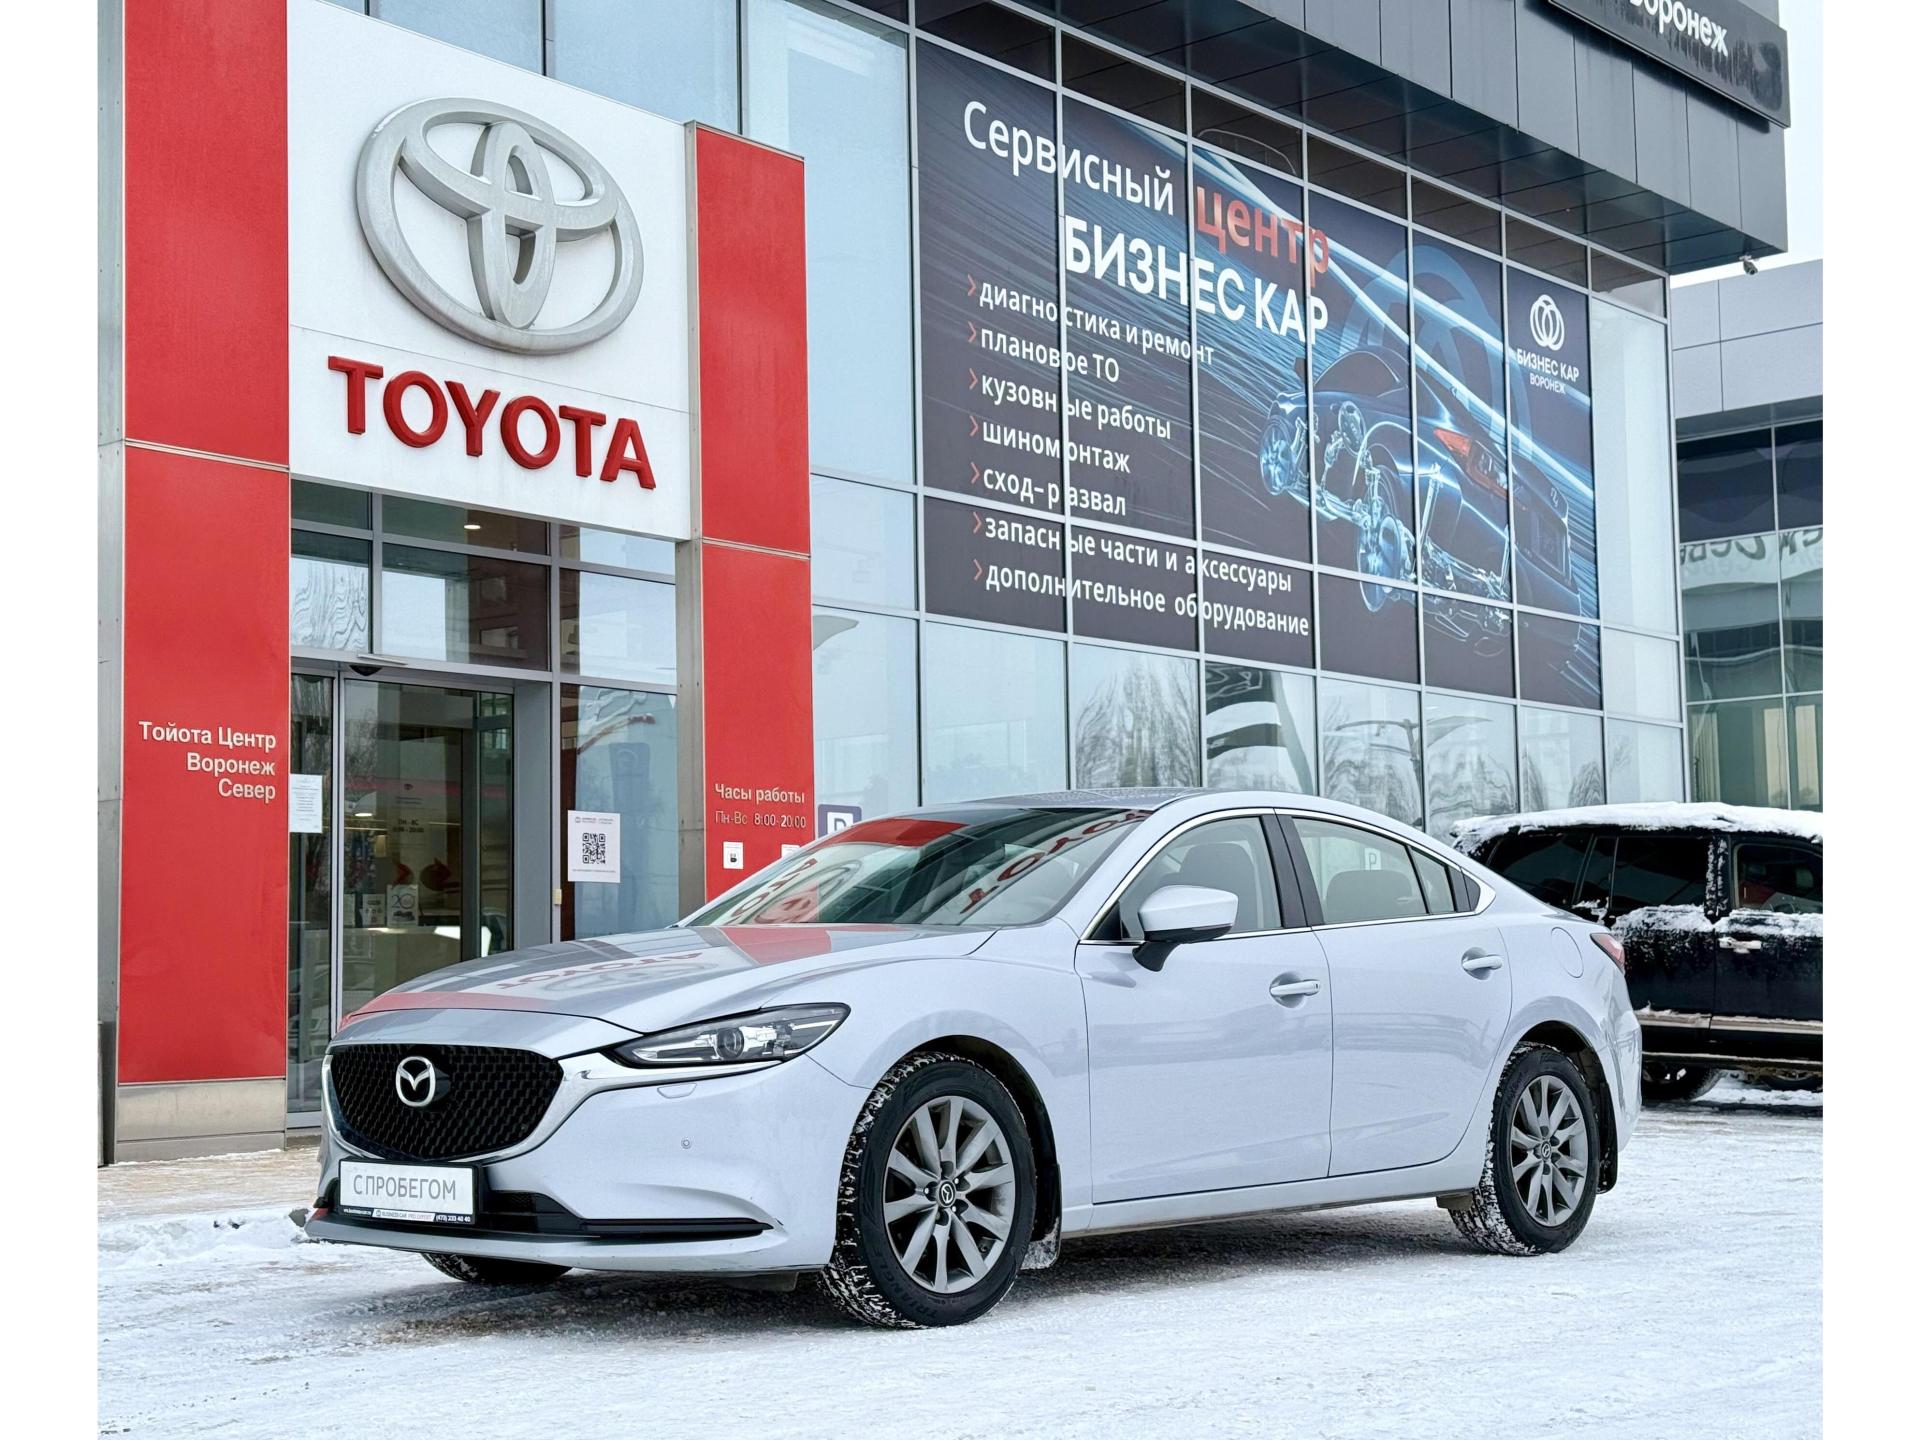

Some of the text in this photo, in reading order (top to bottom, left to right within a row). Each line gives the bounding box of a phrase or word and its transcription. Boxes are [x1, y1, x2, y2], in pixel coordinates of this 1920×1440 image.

[1629, 0, 1729, 57] оронеж
[963, 100, 1330, 287] Сервисный центр
[1064, 214, 1329, 345] БИЗНЕС КАР
[979, 280, 1214, 366] диагностика и ремонт
[981, 327, 1120, 383] плановое ТО
[1516, 348, 1580, 382] БИЗНЕС КАР
[981, 373, 1171, 440] кузовные работы
[1529, 373, 1566, 394] ВОРОНЕЖ
[328, 355, 657, 490] TOYOTA
[983, 421, 1131, 474] шиномонтаж
[983, 467, 1126, 516] сход-развал
[985, 516, 1292, 593] запасные части и аксессуары
[986, 564, 1309, 636] дополнительное оборудование
[139, 721, 276, 752] Тойота Центр
[187, 752, 276, 777] Воронеж
[218, 779, 276, 803] Север
[715, 783, 805, 804] Часы работы
[715, 811, 748, 825] Пн-Вс
[365, 1175, 456, 1200] ПРОБЕГОМ
